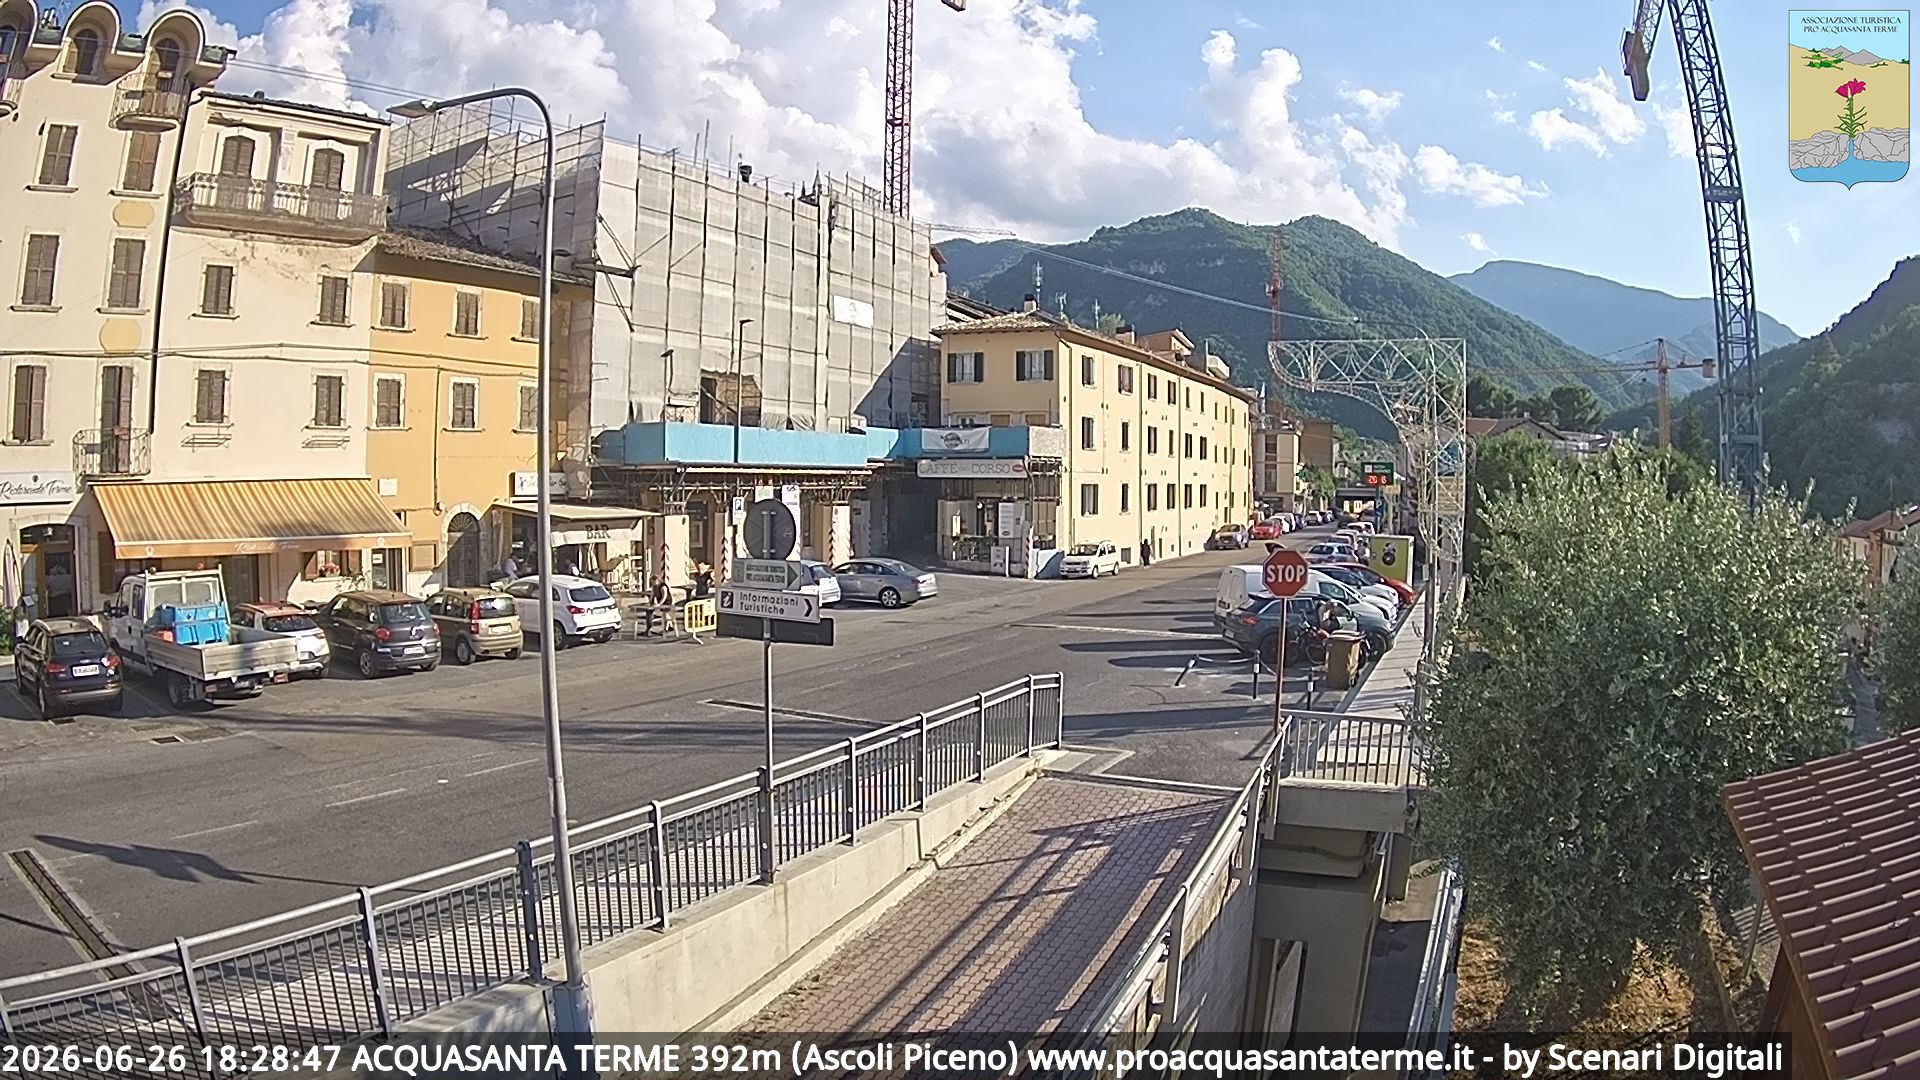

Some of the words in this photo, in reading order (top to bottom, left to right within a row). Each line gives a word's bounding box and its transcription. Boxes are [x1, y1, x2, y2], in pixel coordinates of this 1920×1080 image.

[971, 462, 1011, 474] CORSO
[584, 524, 611, 540] BAR
[1266, 564, 1306, 583] STOP
[739, 591, 799, 607] Informazioni
[739, 602, 785, 615] Turistiche
